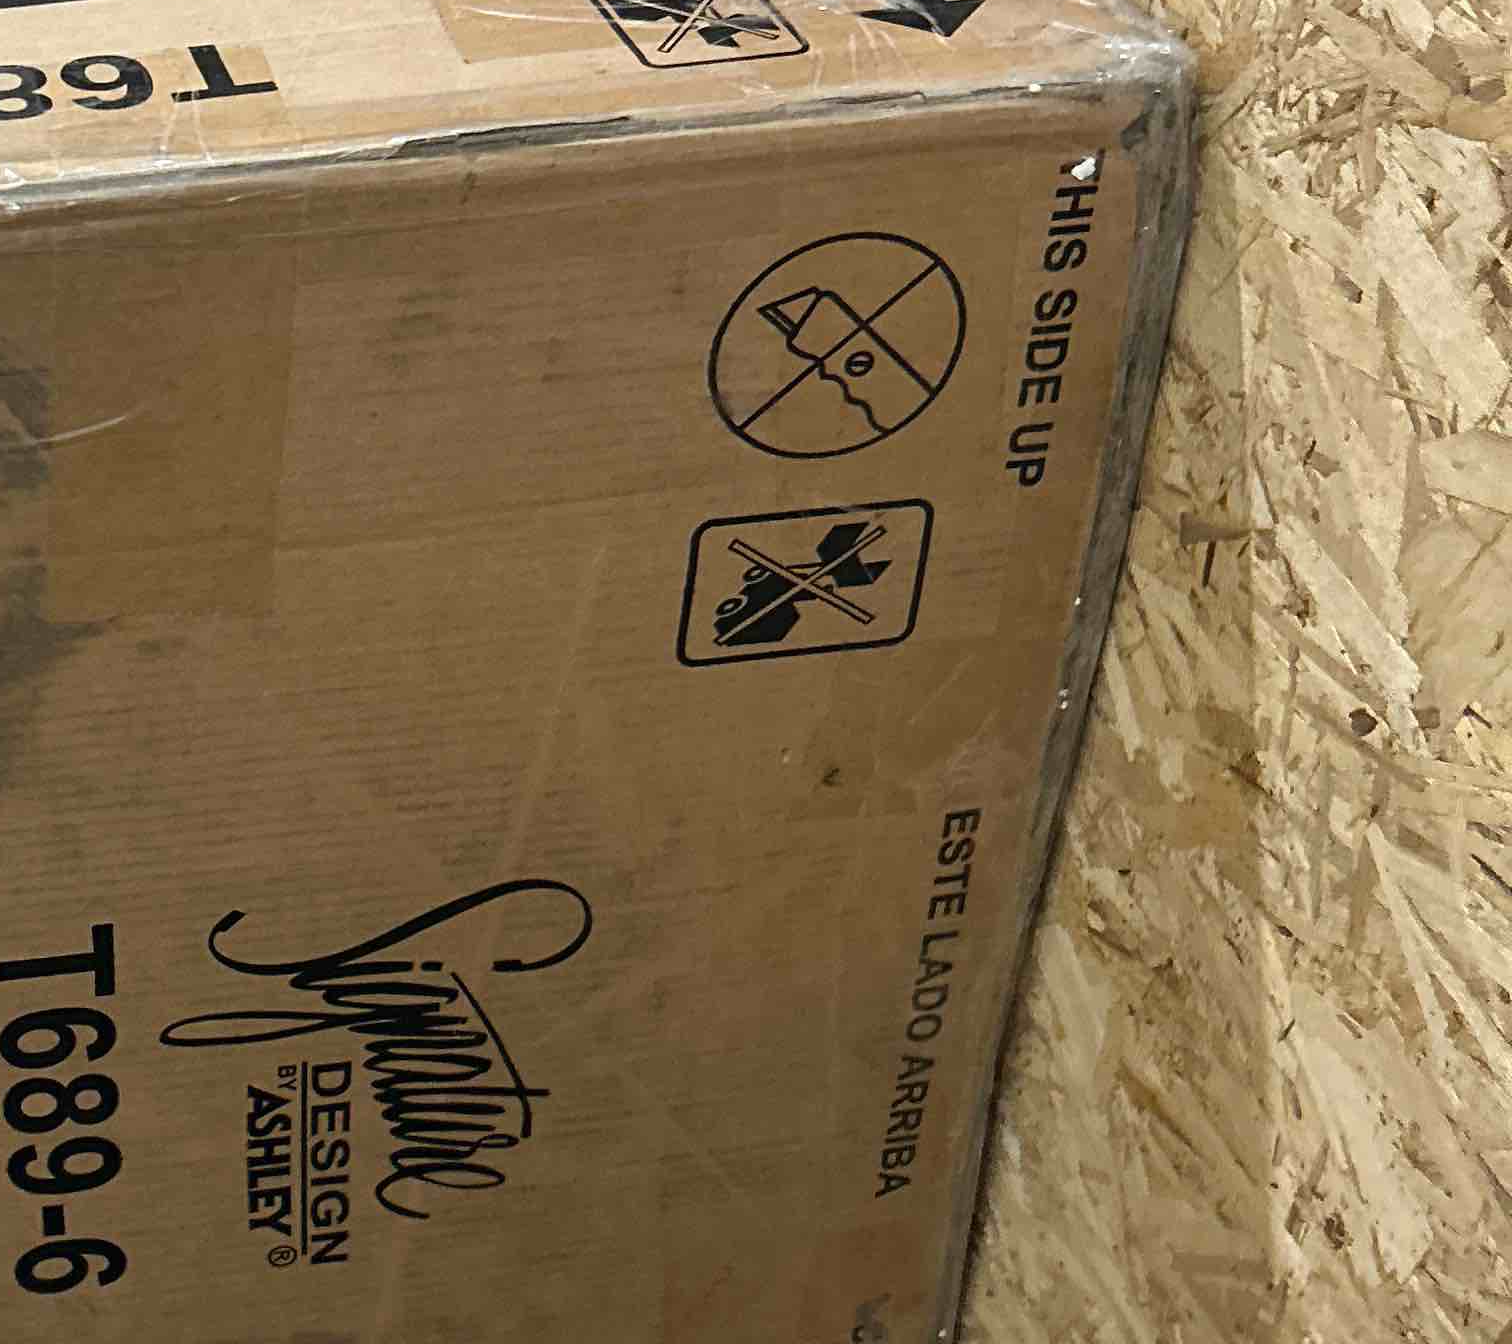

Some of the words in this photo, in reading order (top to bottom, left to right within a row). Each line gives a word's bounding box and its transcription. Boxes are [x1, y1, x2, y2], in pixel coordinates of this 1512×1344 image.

[1017, 288, 1078, 408] SIDE
[1004, 421, 1055, 488] UP
[927, 807, 983, 921] ESTE
[906, 930, 960, 1043] LADO
[159, 879, 593, 1220] Signature
[277, 1064, 298, 1092] BY
[246, 1084, 293, 1238] ASHLEY
[310, 1060, 353, 1265] DESIGN
[874, 1055, 935, 1198] ARRIBA
